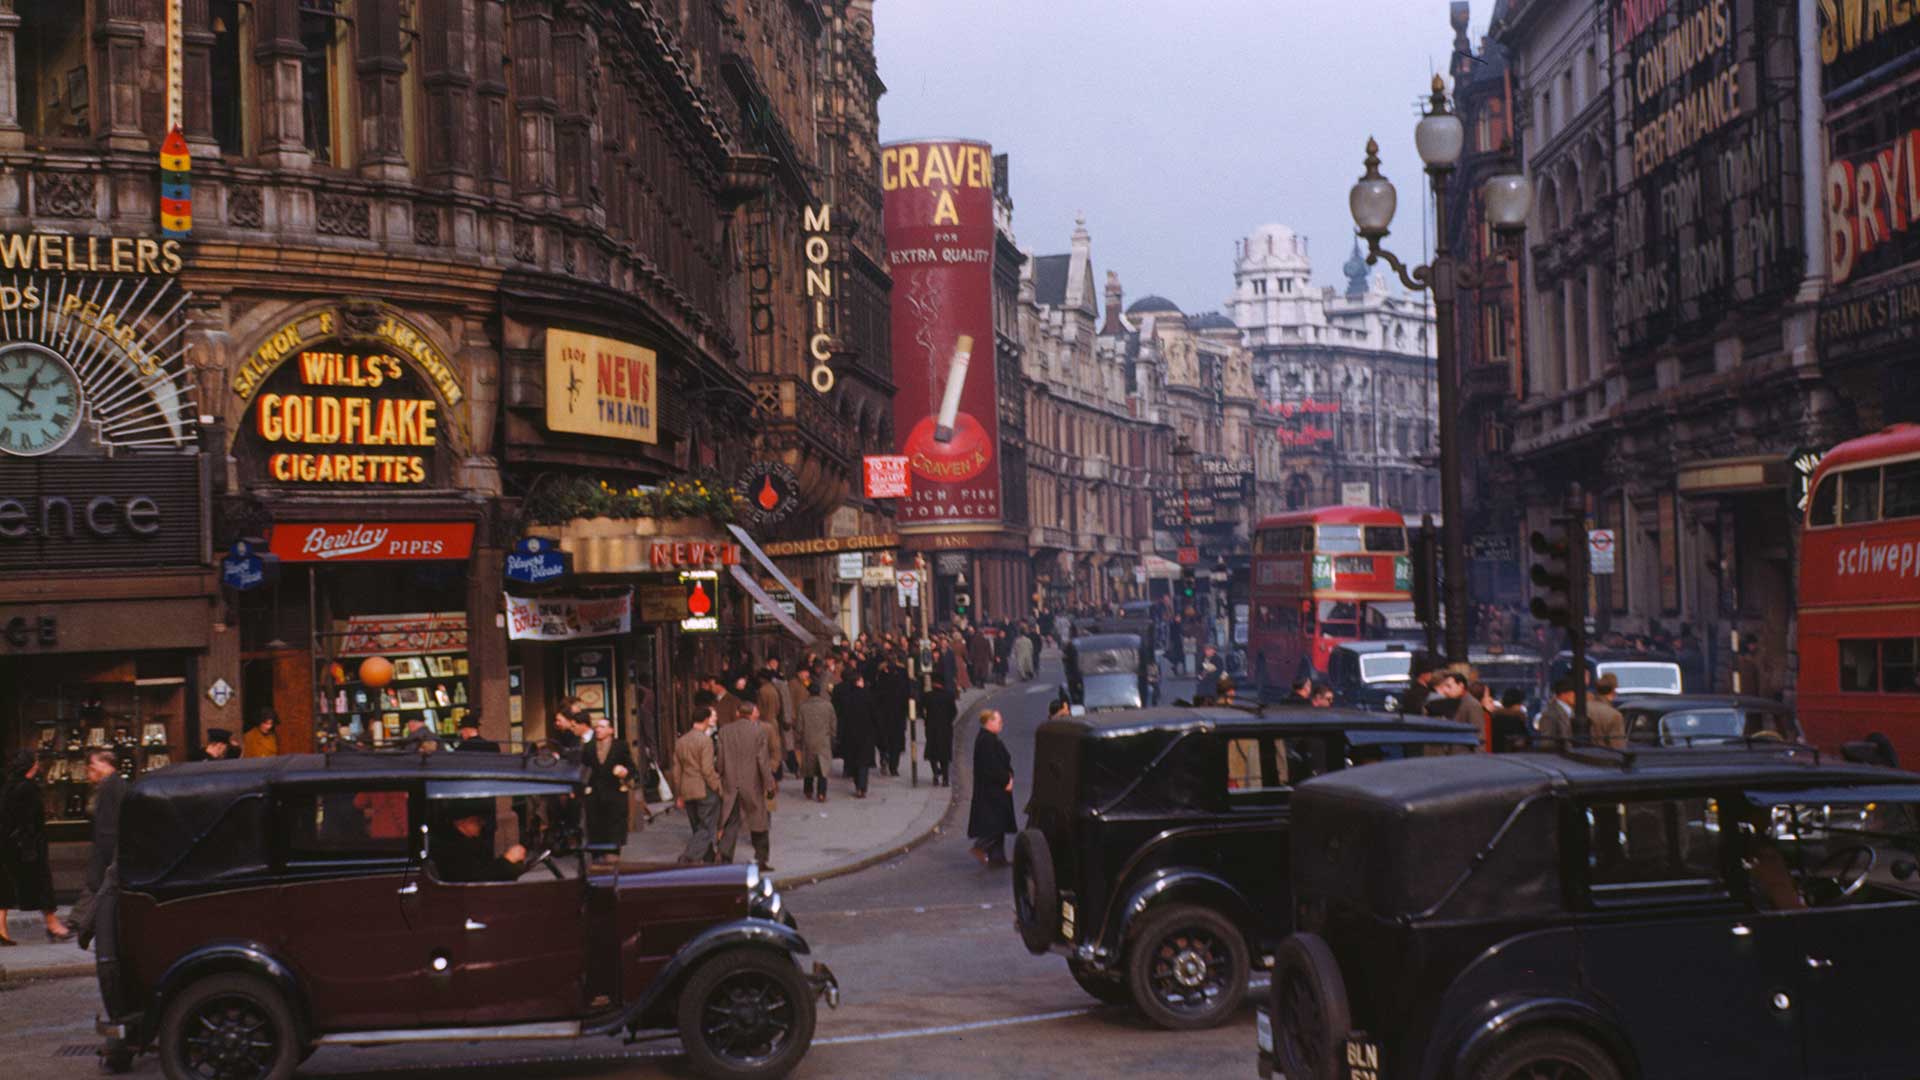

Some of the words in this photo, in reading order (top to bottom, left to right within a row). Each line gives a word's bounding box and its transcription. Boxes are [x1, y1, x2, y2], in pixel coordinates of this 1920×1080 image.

[1633, 63, 1741, 178] PERFORMANCE
[881, 144, 992, 191] CRAVEN
[934, 233, 959, 243] FOR
[0, 233, 183, 274] WELLERS
[891, 248, 938, 265] EXTRA
[942, 247, 990, 264] QUALITY
[803, 203, 836, 394] MONICO
[232, 323, 302, 400] SALMON
[597, 351, 649, 404] NEWS
[269, 453, 426, 483] CIGARETTES
[912, 452, 970, 476] CRAVEN
[905, 505, 997, 516] TOBACCO
[389, 541, 444, 554] PIPES
[765, 538, 839, 557] MONICO
[846, 533, 894, 550] GRILL
[935, 536, 969, 546] BANK
[652, 542, 718, 565] NEWS
